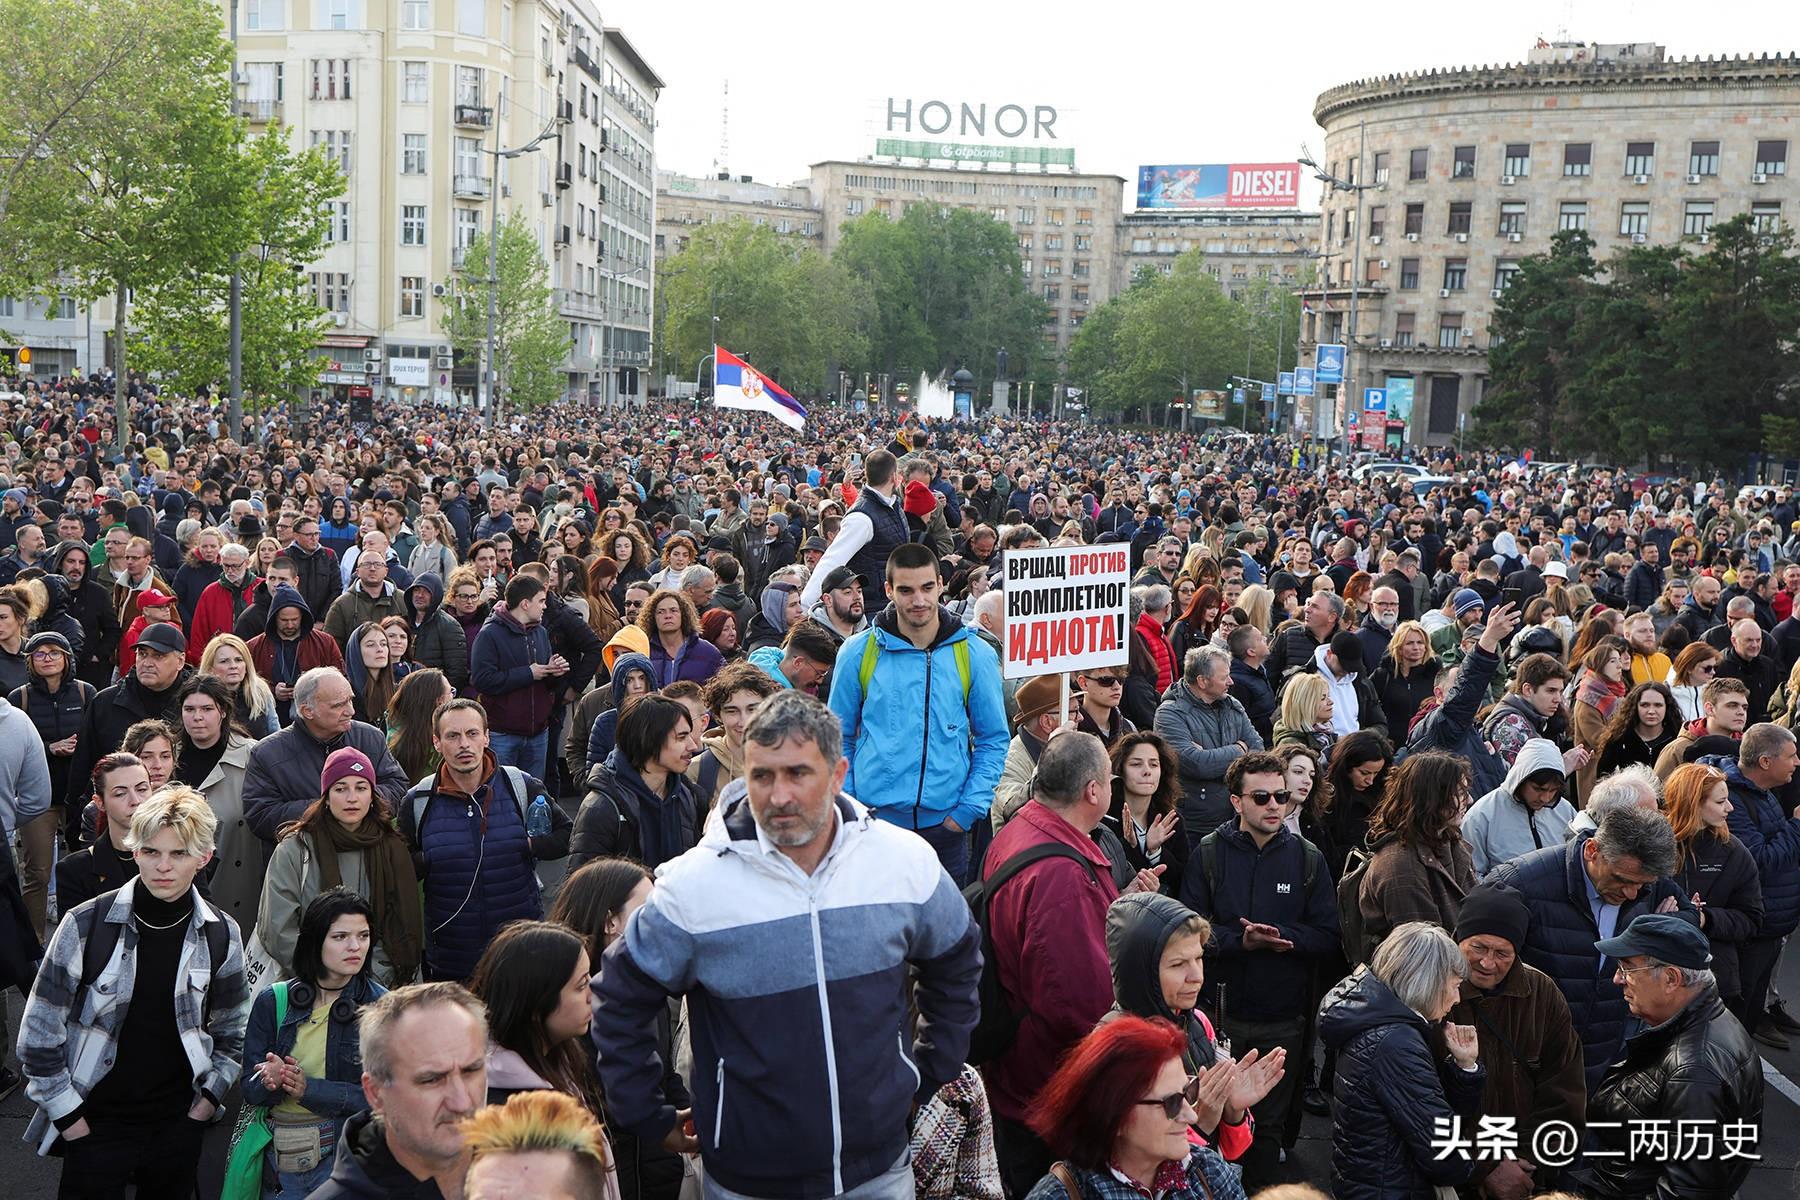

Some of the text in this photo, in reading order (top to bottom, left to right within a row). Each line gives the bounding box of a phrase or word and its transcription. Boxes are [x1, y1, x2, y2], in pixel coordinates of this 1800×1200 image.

[887, 97, 1057, 139] HONOR
[1232, 170, 1295, 196] DIESEL
[1369, 390, 1382, 408] P
[1009, 551, 1126, 580] ВРШАЦ ПРОТИВ
[1008, 582, 1126, 617] КОМПЛЕТНОГ
[1009, 613, 1124, 666] ИДИОТА!
